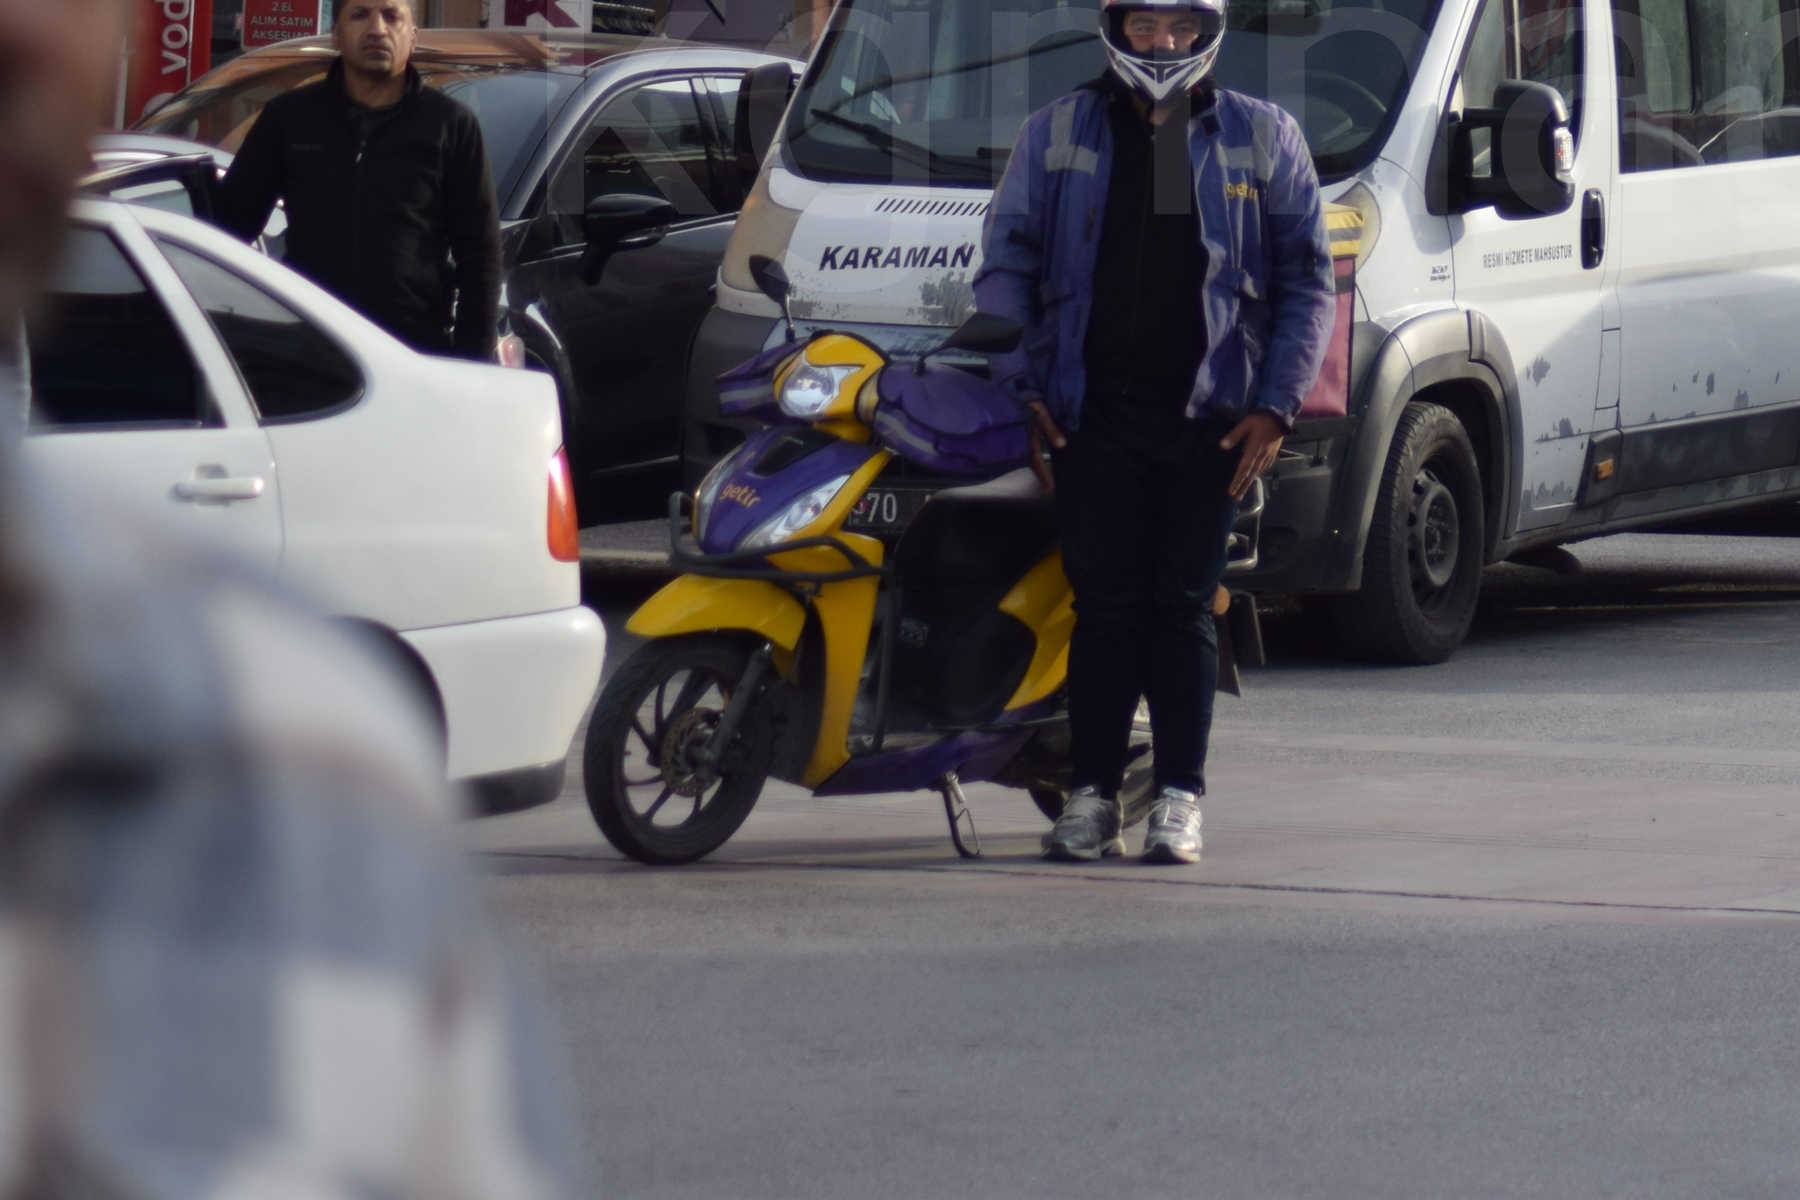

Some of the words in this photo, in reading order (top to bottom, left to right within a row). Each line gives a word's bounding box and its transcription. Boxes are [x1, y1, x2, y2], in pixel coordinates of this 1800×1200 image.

[818, 242, 977, 272] KARAMAN
[720, 484, 760, 509] getir
[867, 492, 897, 523] 70
